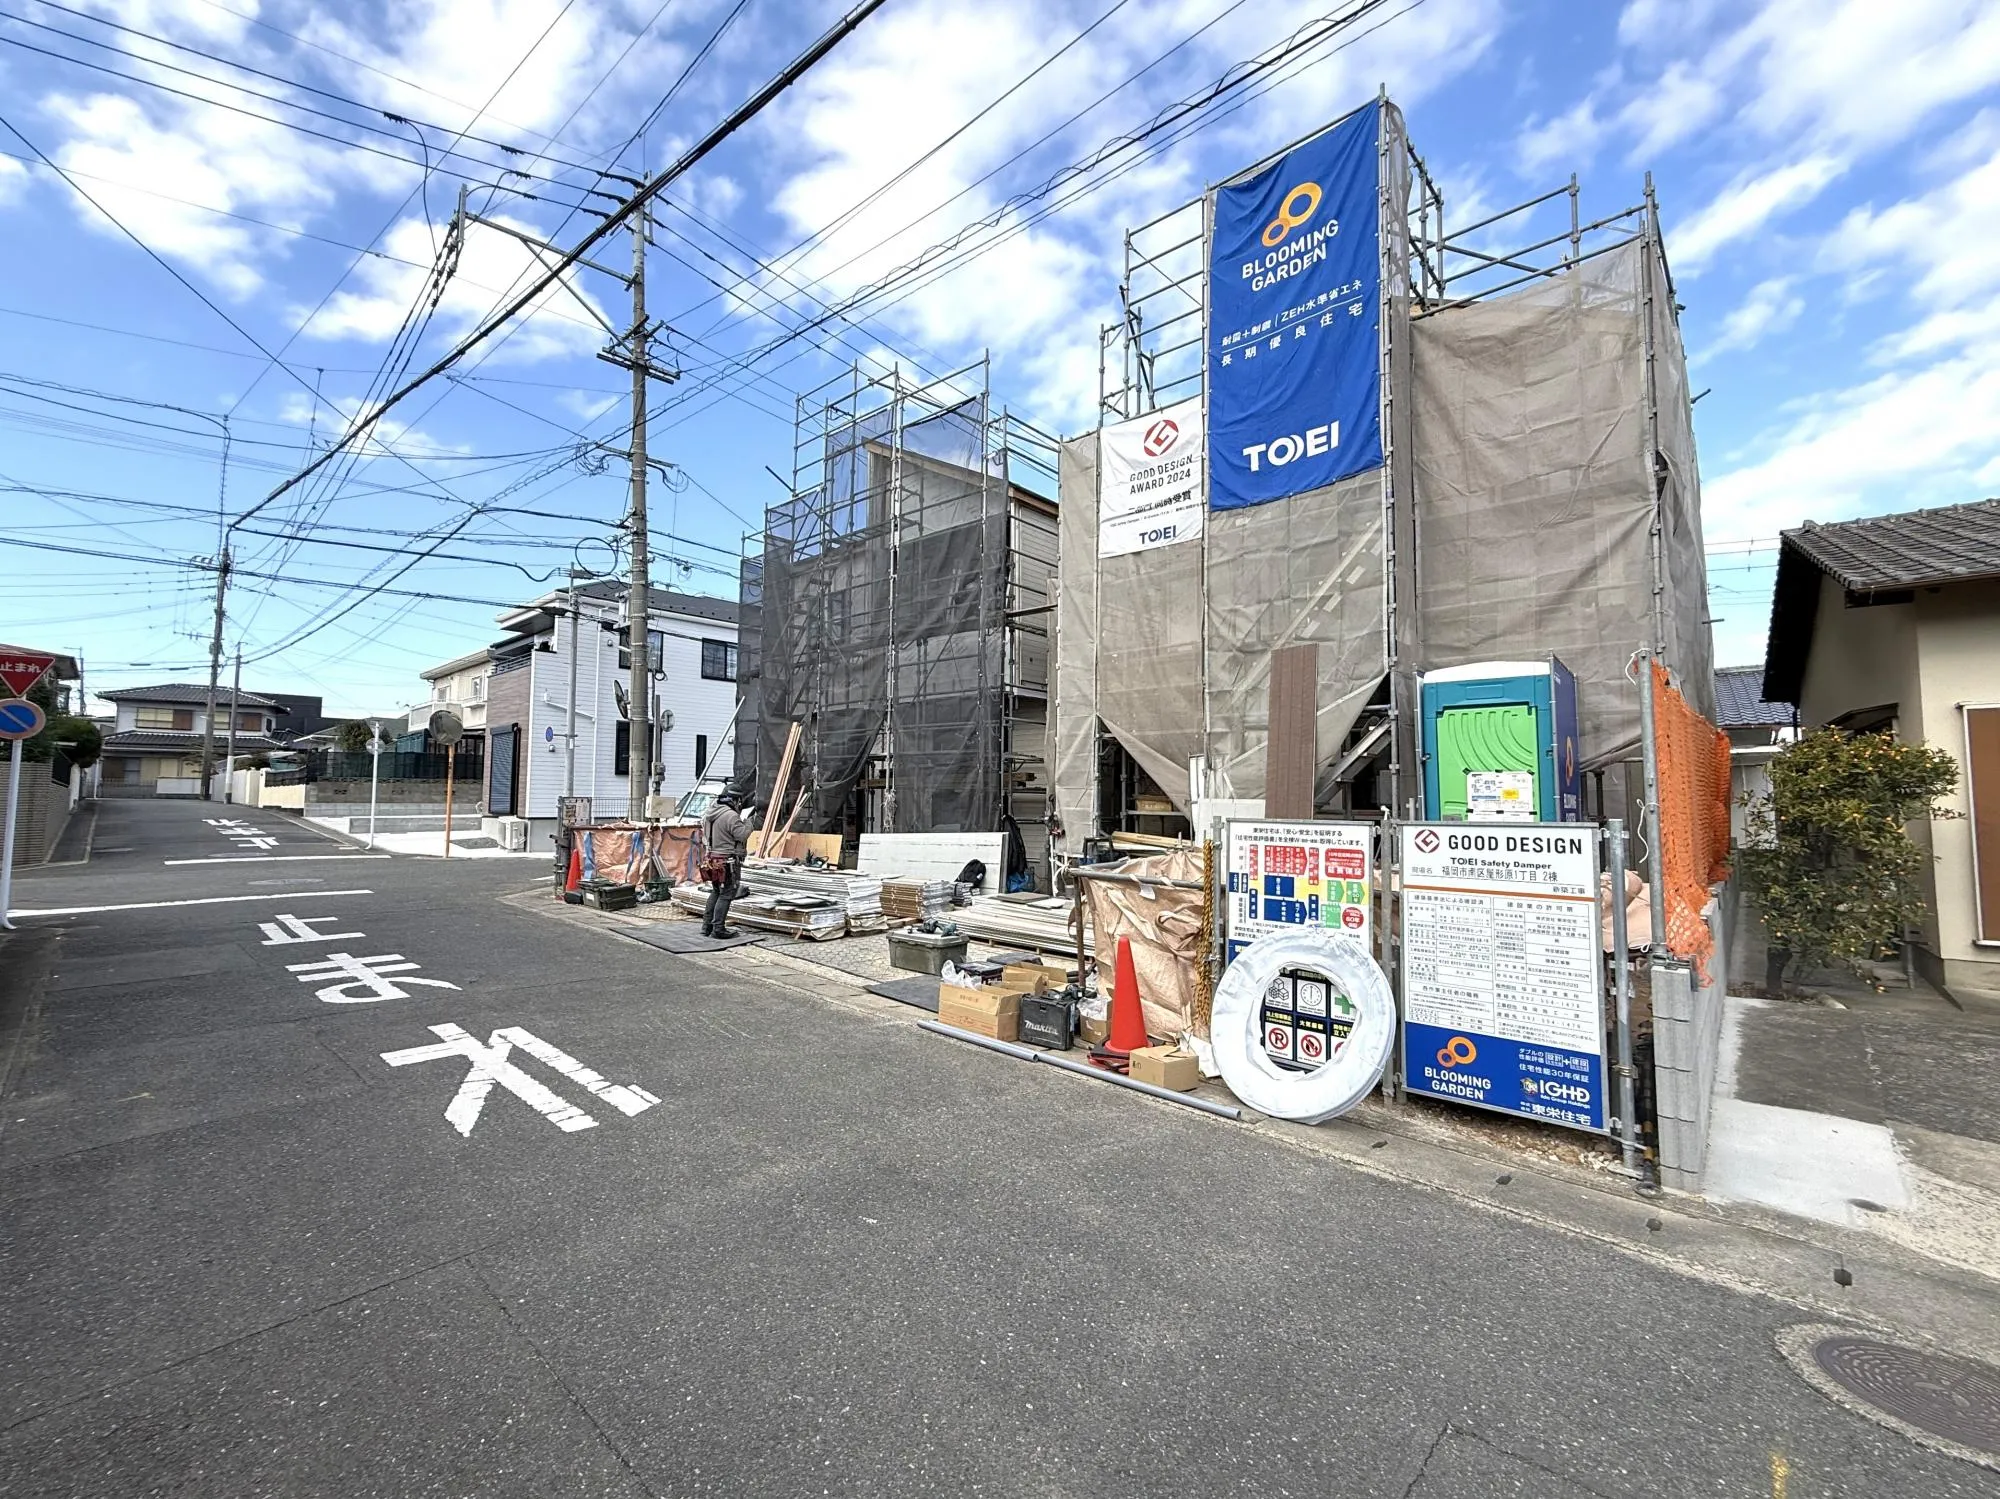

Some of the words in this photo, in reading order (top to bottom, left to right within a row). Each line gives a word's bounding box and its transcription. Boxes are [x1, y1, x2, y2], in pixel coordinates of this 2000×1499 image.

[1242, 219, 1339, 279] BLOOMING
[1251, 243, 1327, 292] GARDEN
[1221, 302, 1363, 367] 長期優良住宅
[1130, 467, 1155, 482] GOOD
[1158, 454, 1193, 475] DESIGN
[1130, 477, 1164, 495] AWARD
[1167, 469, 1191, 485] 2024
[0, 661, 42, 673] 止まれ
[1448, 834, 1499, 851] GOOD
[1506, 836, 1582, 855] DESIGN
[1480, 859, 1510, 869] Safety
[1513, 861, 1552, 870] Damper
[1424, 1066, 1491, 1090] BLOOMING
[1519, 1063, 1589, 1083] 住宅性能30年保証
[1431, 1080, 1484, 1101] GARDEN
[1531, 1103, 1591, 1126] 東栄住宅
